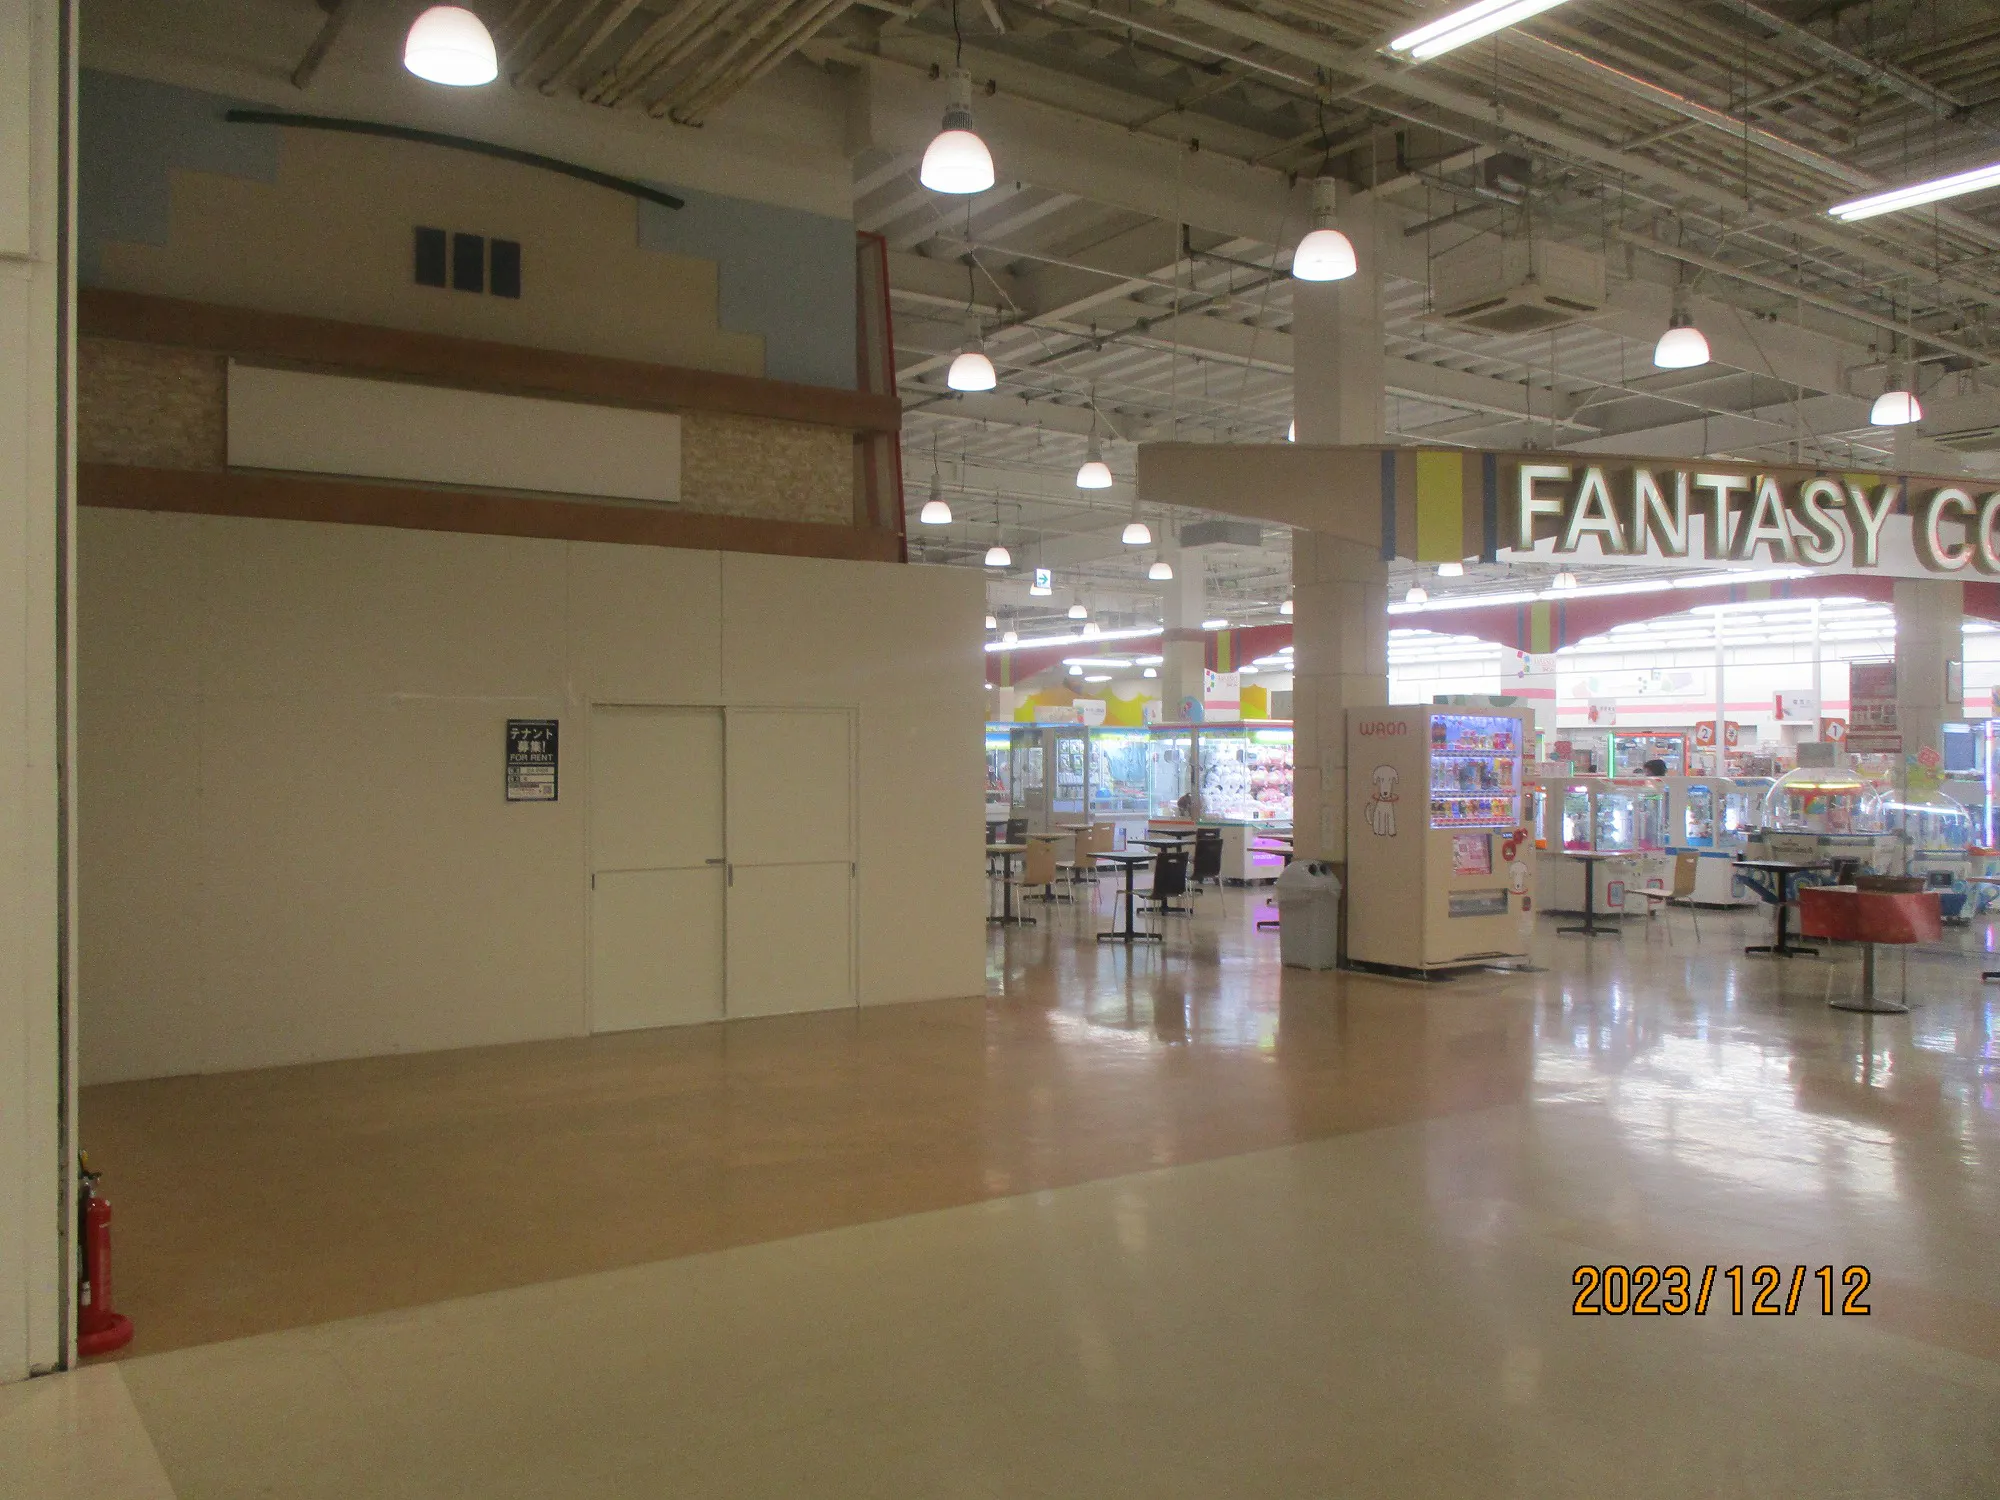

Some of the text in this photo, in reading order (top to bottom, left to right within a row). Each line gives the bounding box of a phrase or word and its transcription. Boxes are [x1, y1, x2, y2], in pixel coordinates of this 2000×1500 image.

[1514, 463, 1901, 568] FANTASY
[510, 728, 553, 740] テナント
[510, 753, 554, 762] FOR RENT
